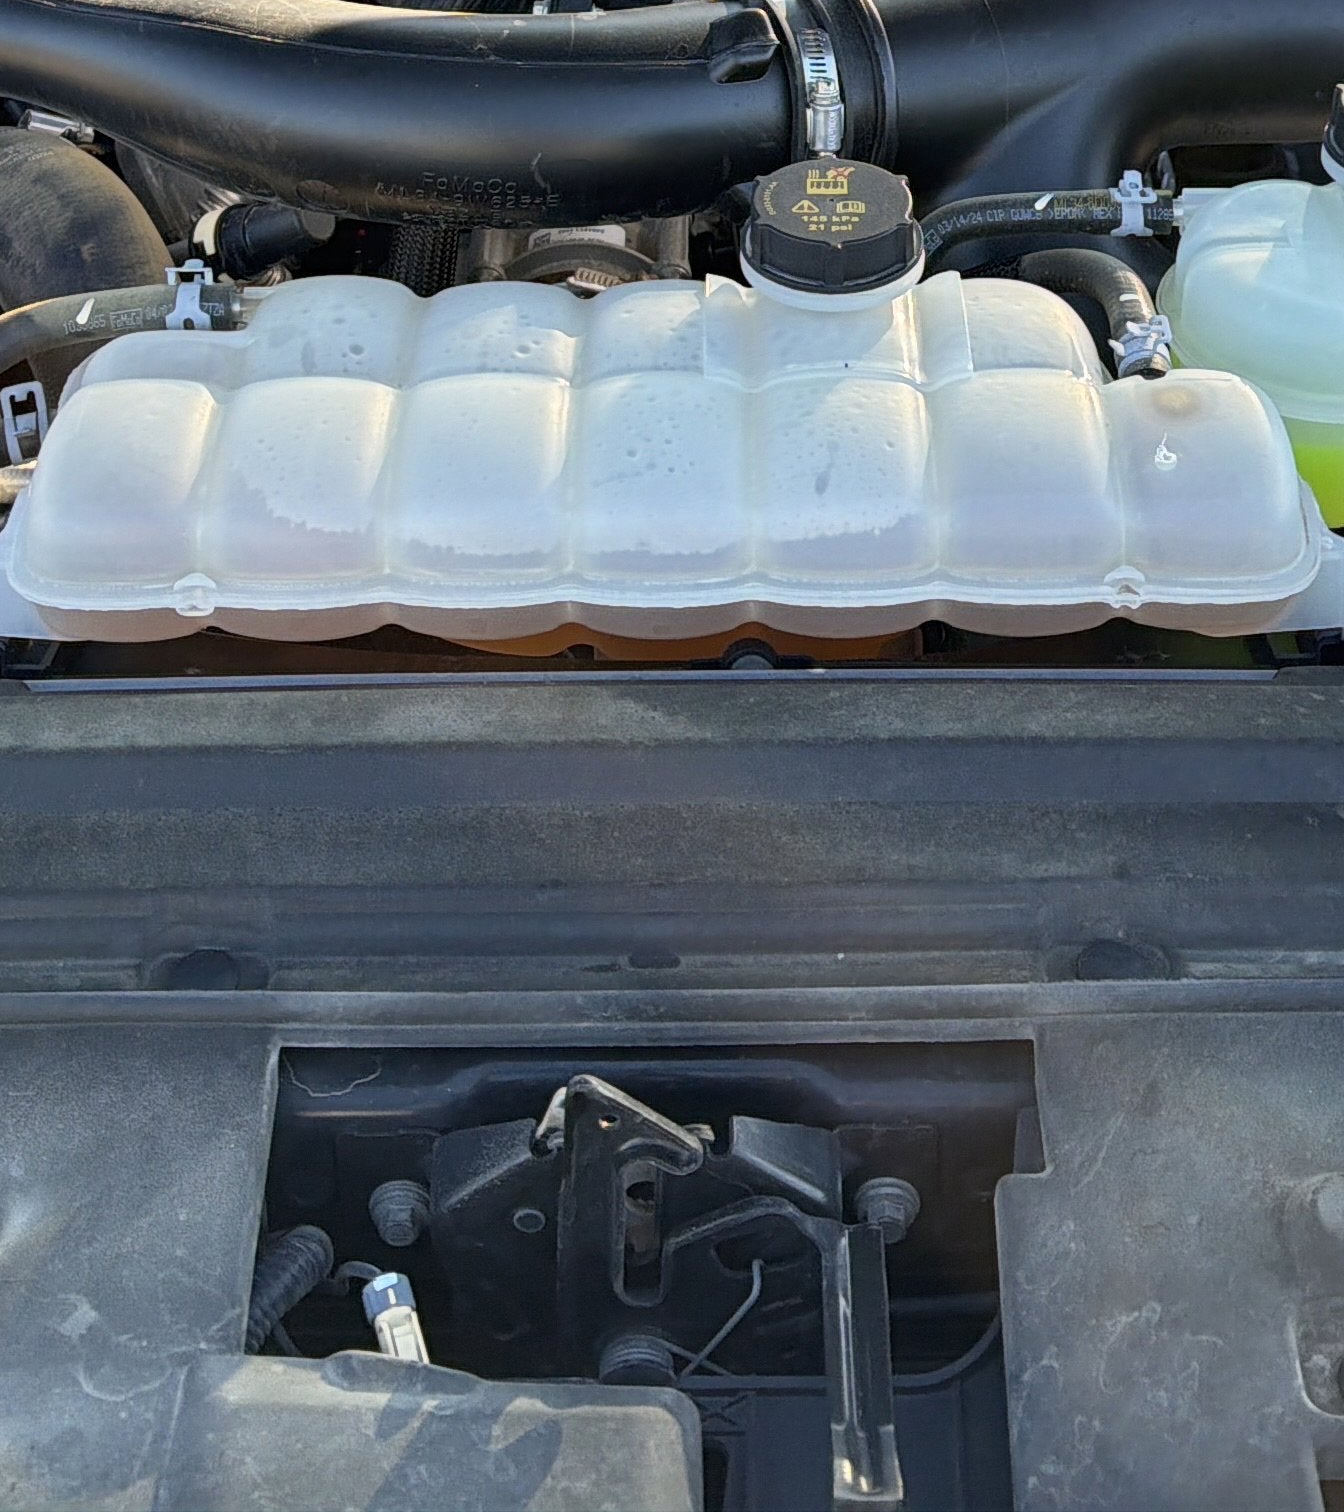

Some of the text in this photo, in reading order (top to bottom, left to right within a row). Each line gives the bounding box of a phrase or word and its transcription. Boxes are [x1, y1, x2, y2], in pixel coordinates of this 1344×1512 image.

[422, 171, 517, 194] FoMoCo
[800, 215, 860, 223] 145 kPa
[937, 212, 984, 236] 03/14/24
[807, 223, 853, 233] 21 psi
